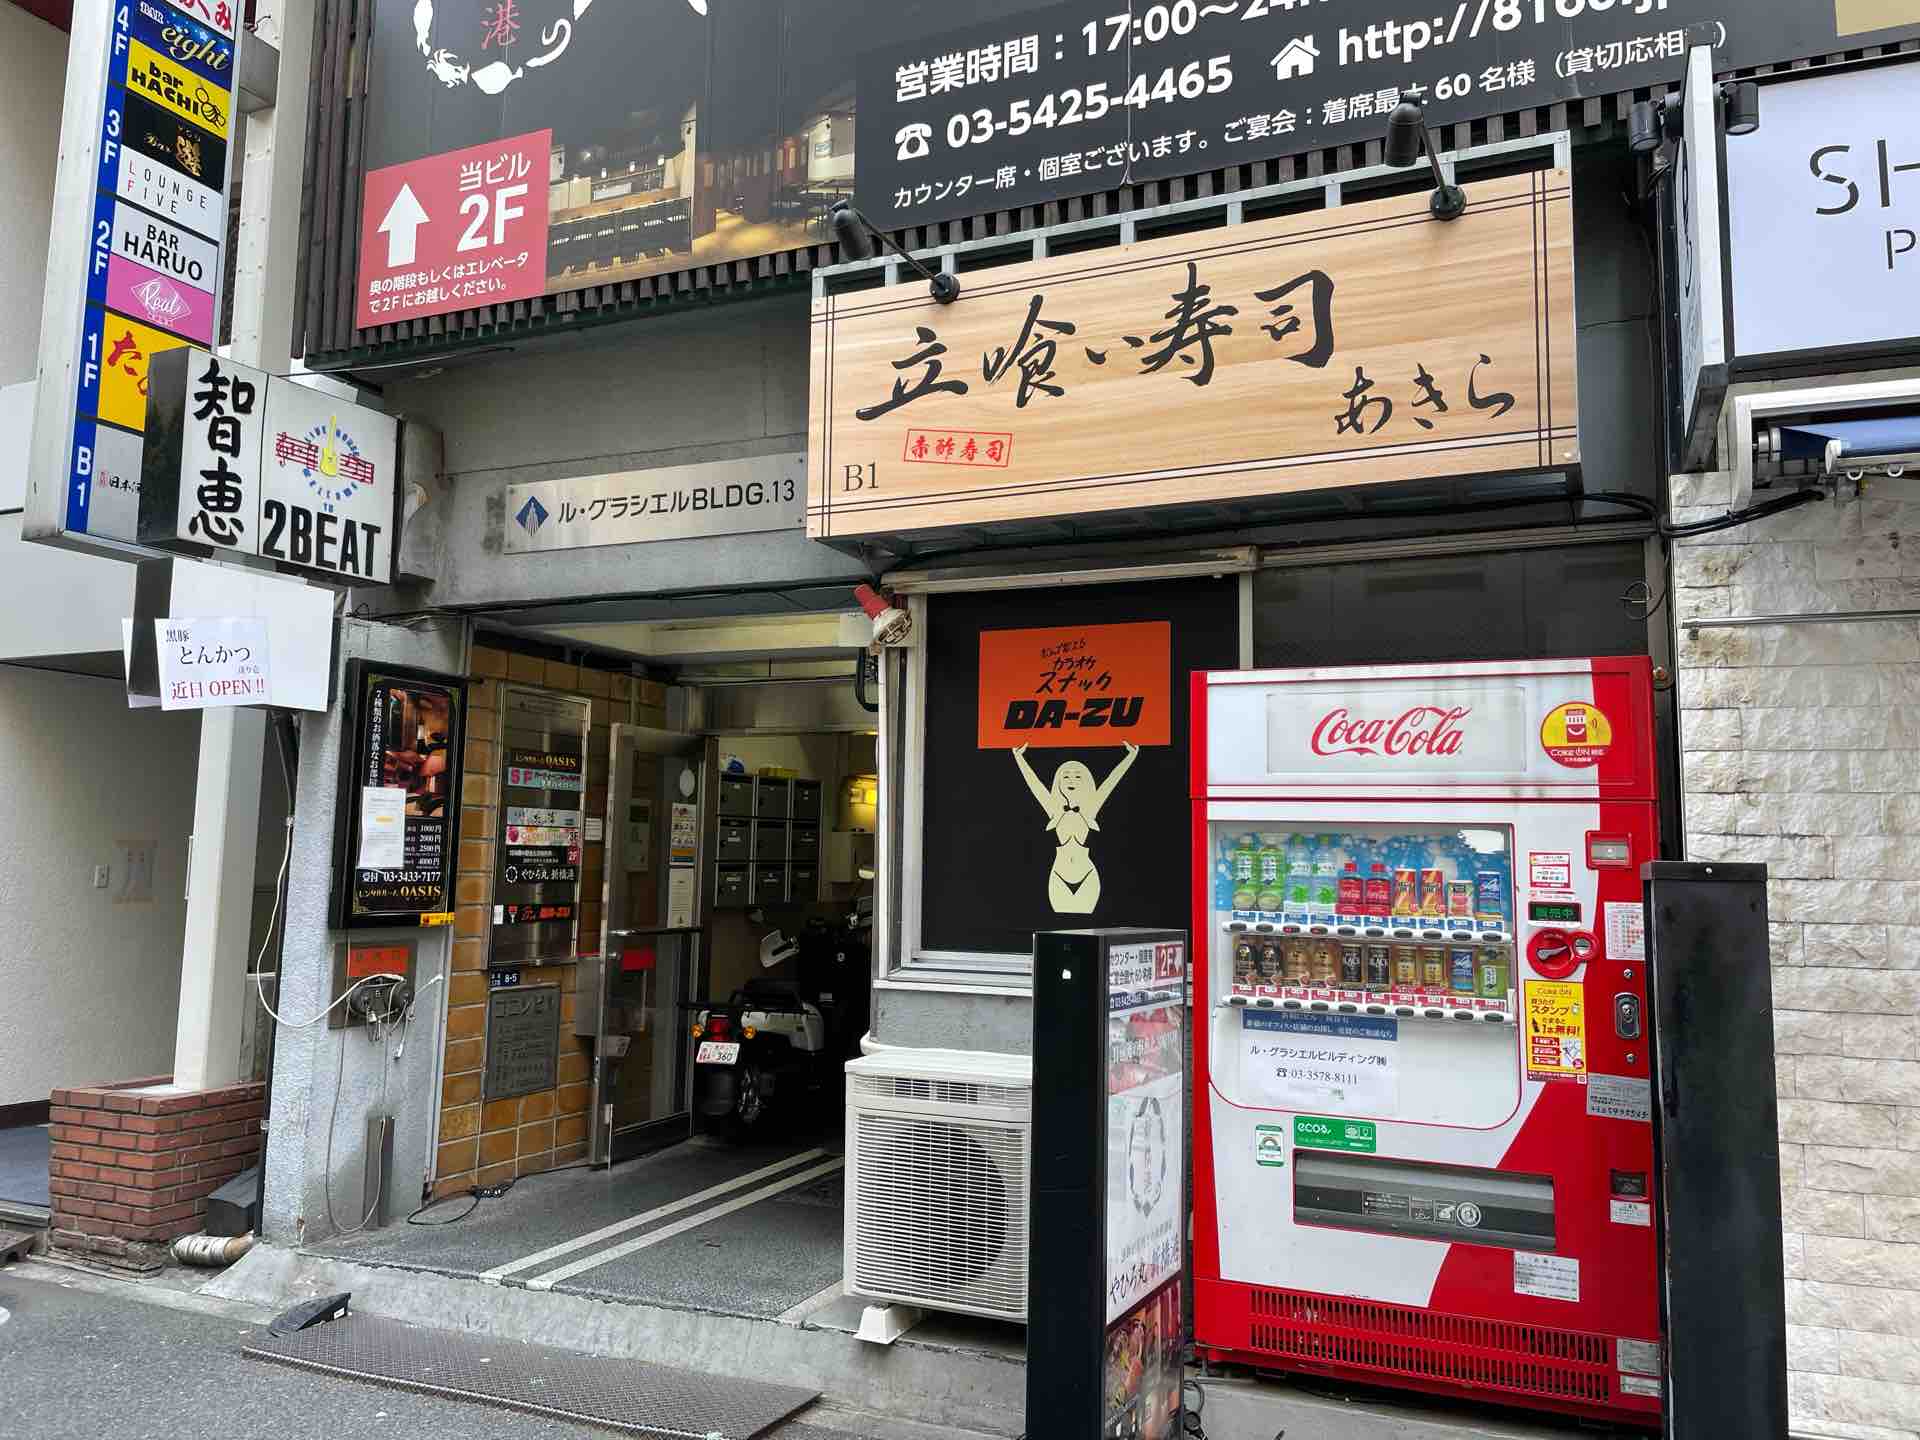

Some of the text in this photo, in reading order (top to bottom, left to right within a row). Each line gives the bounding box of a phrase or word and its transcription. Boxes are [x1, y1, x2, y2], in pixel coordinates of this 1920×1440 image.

[140, 2, 164, 25] BAR
[161, 26, 229, 71] eight
[1436, 73, 1472, 101] 60
[1554, 21, 1727, 79] （貸切応相）
[131, 67, 199, 116] HACHI
[149, 61, 184, 88] bar
[946, 55, 1233, 148] 03-5425-4465
[129, 159, 208, 209] LOUNGE
[459, 151, 532, 192] 当ビル
[127, 179, 177, 214] FIVE
[456, 184, 528, 252] 2F
[124, 232, 203, 281] HARUO
[146, 224, 179, 250] BAR
[369, 252, 529, 297] 奥の階段もしくはエレベータ
[856, 261, 1335, 421] 立喰い寿司
[1336, 354, 1515, 435] あきら
[189, 358, 256, 546] 智恵
[841, 462, 880, 491] B1
[558, 479, 795, 524] ル・グラシエルBLDG.13
[262, 499, 382, 578] 2BEAT
[178, 645, 251, 665] とんかつ
[171, 680, 203, 701] 近日
[208, 679, 251, 698] OPEN
[1035, 671, 1113, 694] スナック
[1004, 696, 1145, 730] DA-ZU
[1311, 705, 1472, 757] Coca-Cola
[400, 885, 441, 897] OASIS
